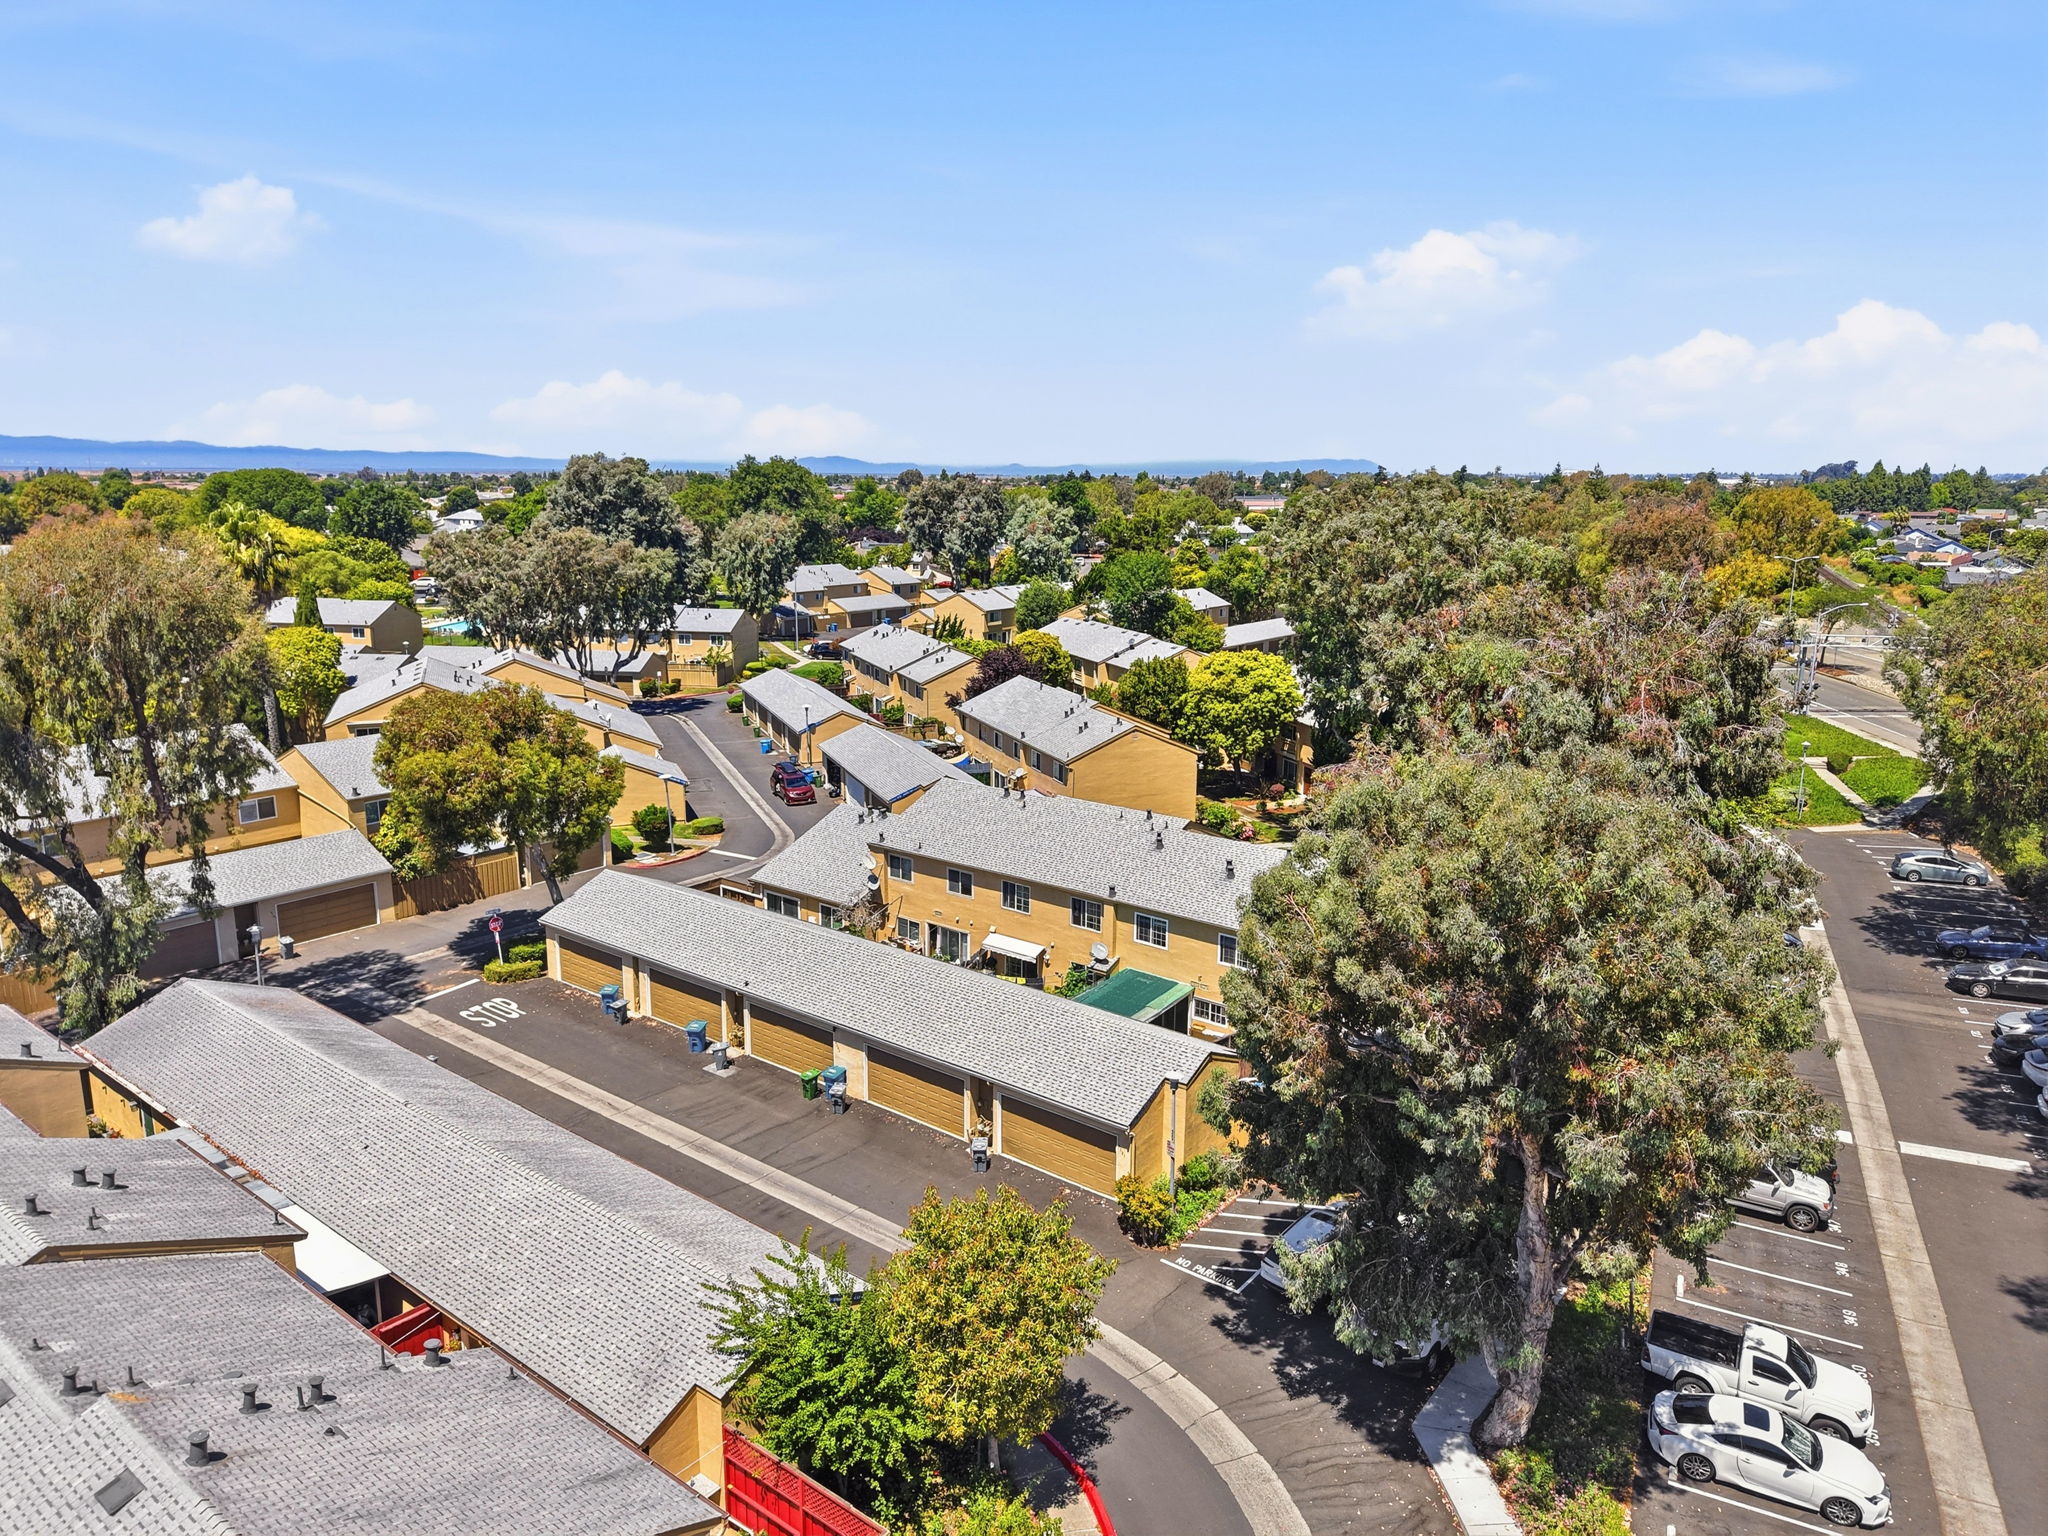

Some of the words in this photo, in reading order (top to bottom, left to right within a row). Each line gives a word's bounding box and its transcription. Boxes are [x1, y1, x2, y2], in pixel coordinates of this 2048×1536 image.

[459, 997, 527, 1027] STOP
[1828, 1219, 1842, 1233] 347
[1175, 1257, 1192, 1268] NO
[1192, 1264, 1236, 1286] PARKING
[1834, 1261, 1850, 1278] 348
[1842, 1309, 1859, 1327] 349
